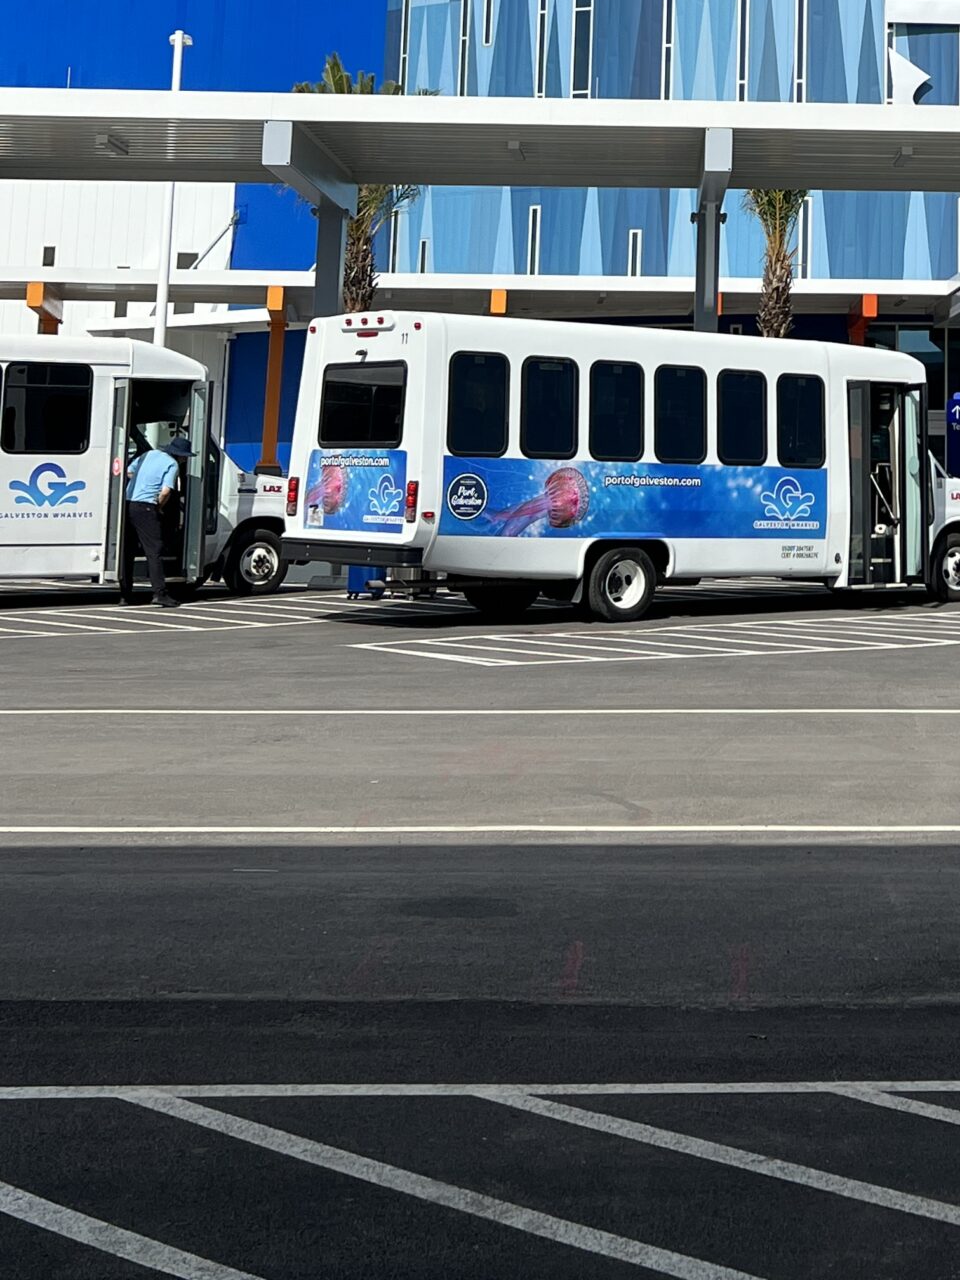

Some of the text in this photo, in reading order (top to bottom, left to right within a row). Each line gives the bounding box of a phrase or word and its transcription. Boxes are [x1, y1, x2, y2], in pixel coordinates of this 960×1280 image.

[401, 332, 409, 345] 11
[320, 455, 390, 468] portofgalveston.com
[605, 475, 701, 487] portofgalveston.com
[263, 485, 282, 493] LAZ
[52, 511, 93, 519] WHARVES
